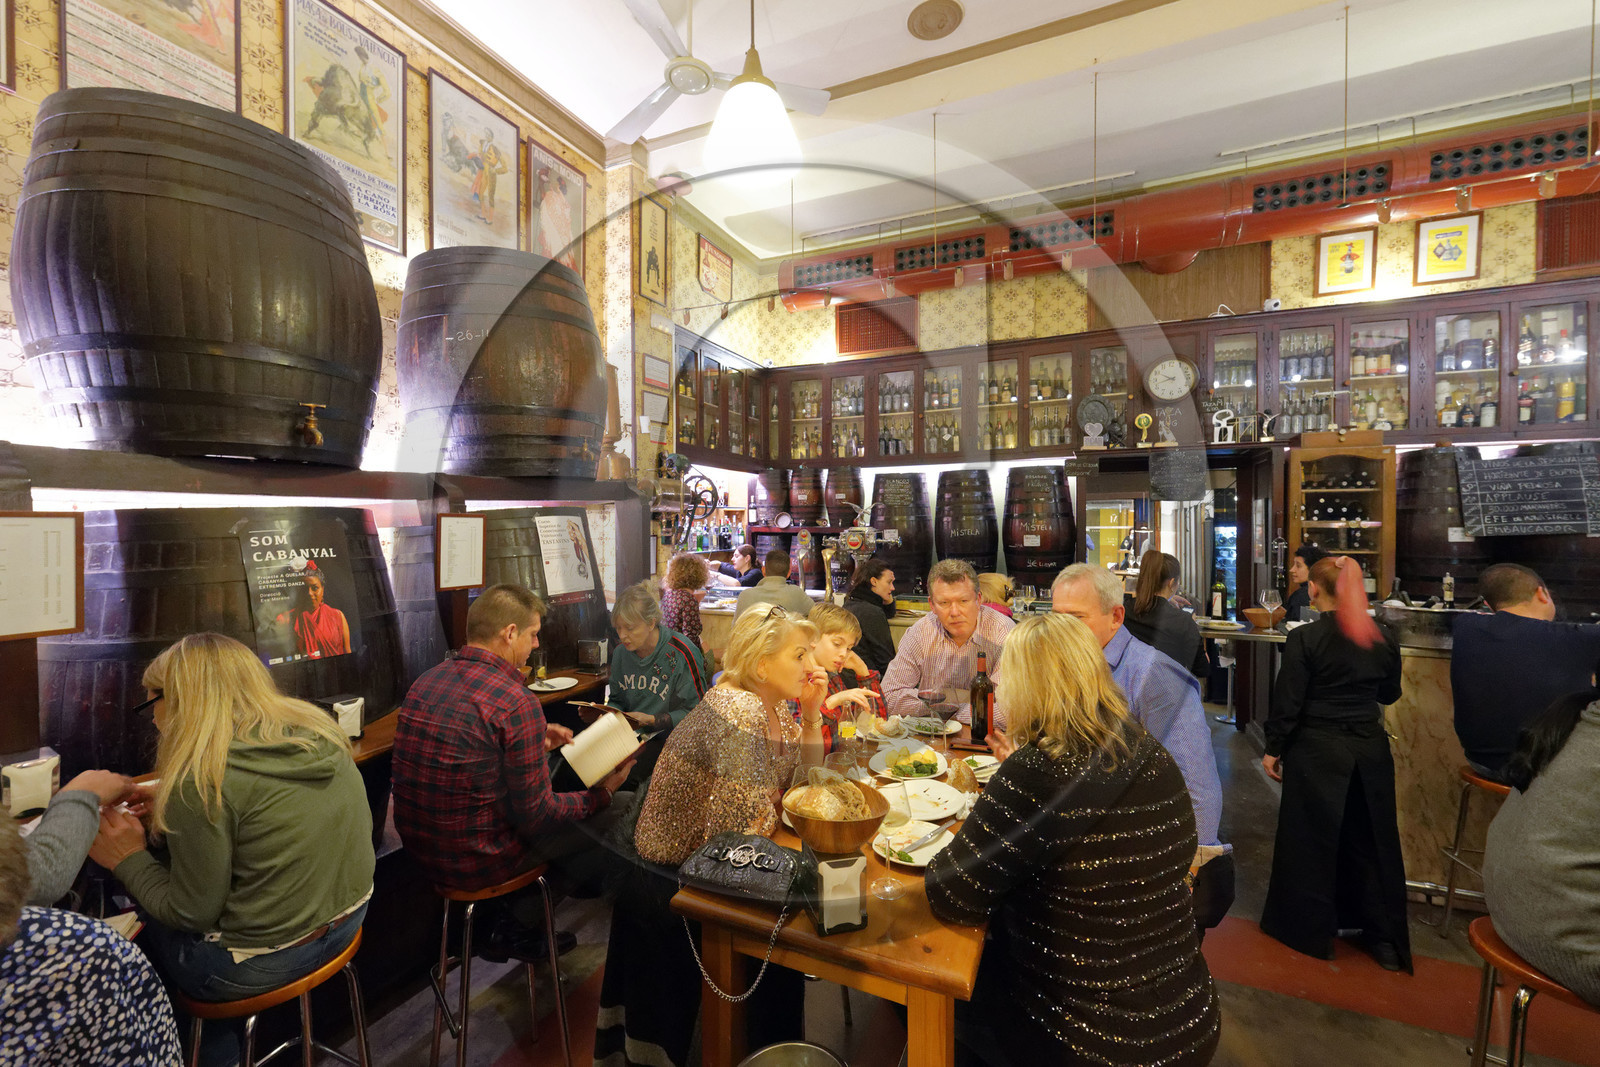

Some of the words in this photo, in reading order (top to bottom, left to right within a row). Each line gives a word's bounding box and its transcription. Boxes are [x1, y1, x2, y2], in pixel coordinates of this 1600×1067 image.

[534, 149, 554, 168] ANIS
[560, 165, 582, 186] MONO
[356, 191, 397, 212] UBRIQUE
[364, 188, 390, 204] CANO
[358, 198, 370, 208] LA
[373, 205, 397, 219] ROSA
[1485, 492, 1550, 502] APPLAUSE
[1485, 515, 1508, 523] EFE
[1487, 525, 1576, 535] EMBAUCADOR
[250, 535, 288, 547] SOM
[253, 548, 337, 562] CABANYAL
[618, 674, 670, 702] AMORE
